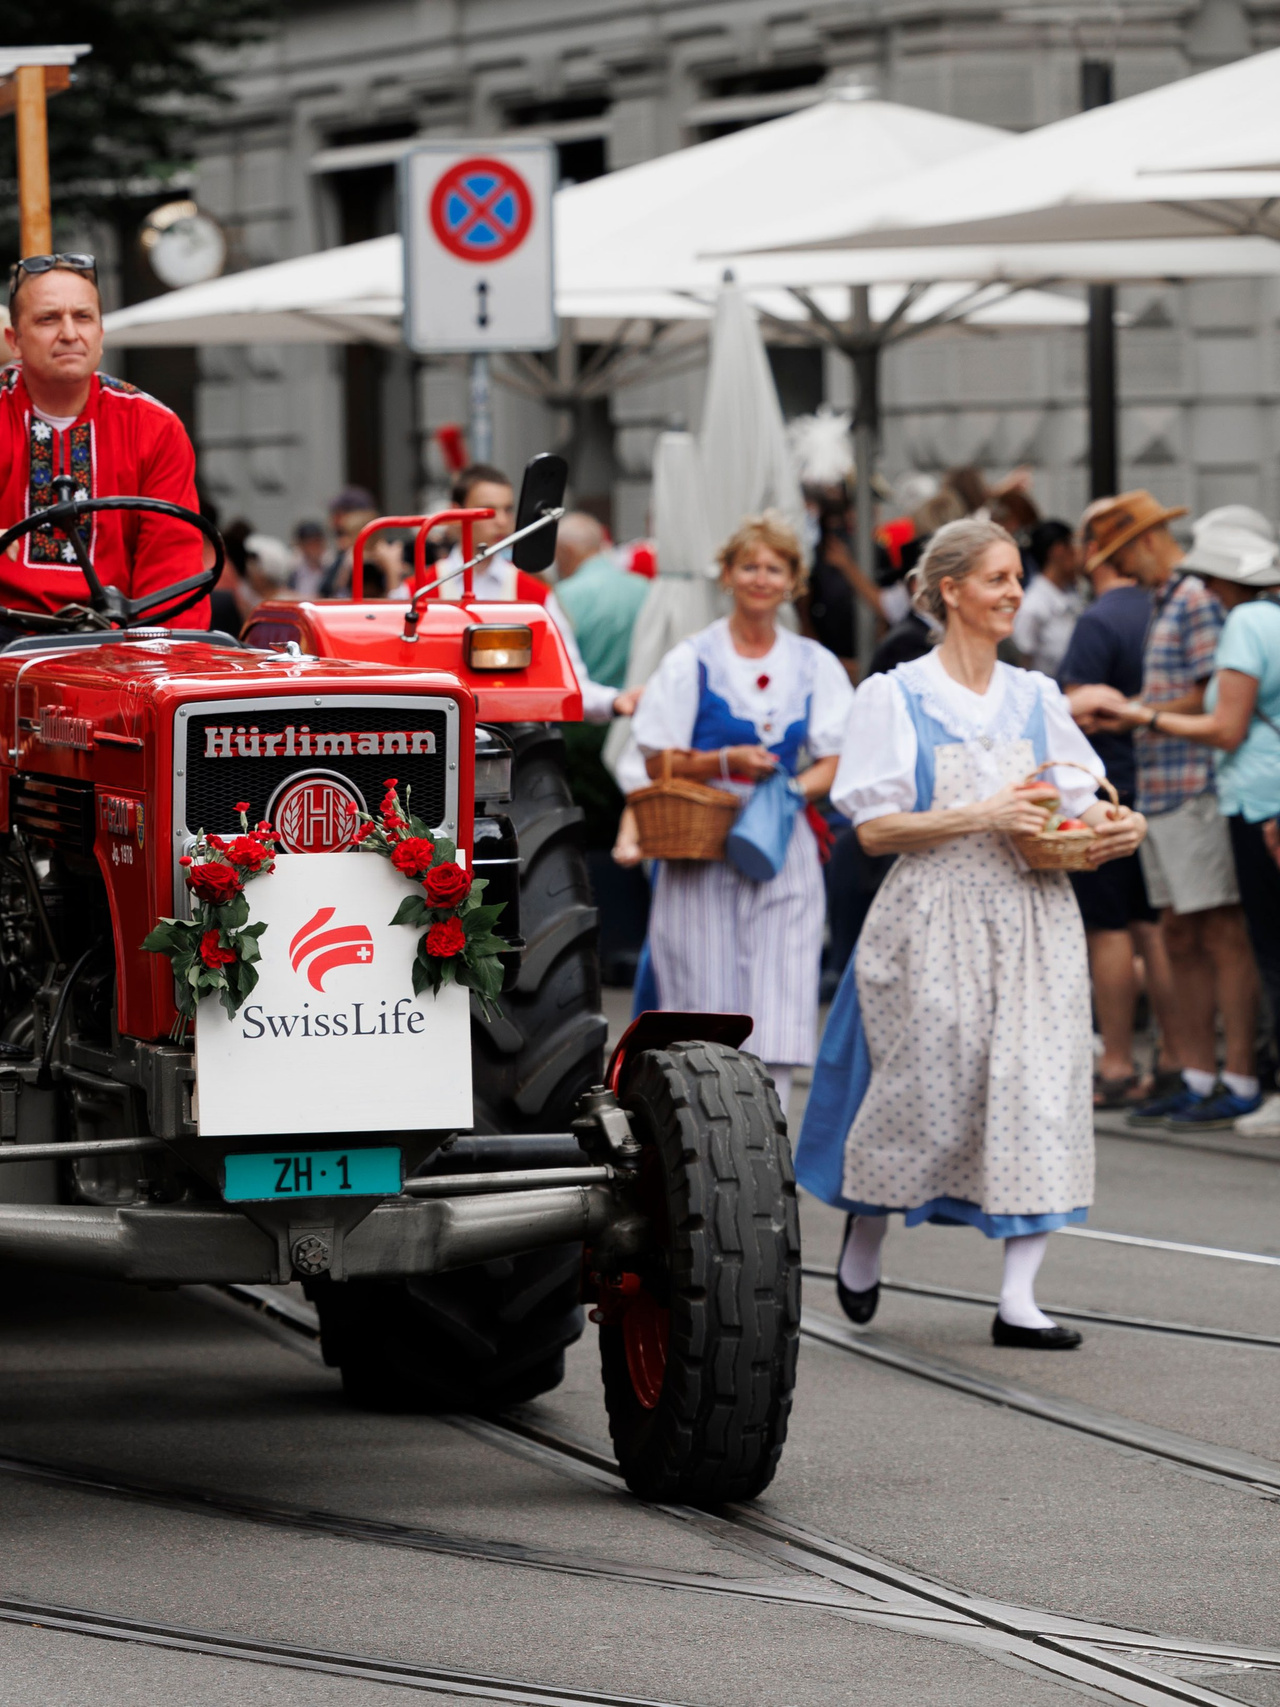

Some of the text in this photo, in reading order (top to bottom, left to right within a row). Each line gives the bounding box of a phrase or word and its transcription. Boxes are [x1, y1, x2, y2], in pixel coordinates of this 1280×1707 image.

[204, 725, 436, 758] Hürlimann
[303, 788, 334, 846] H
[242, 998, 425, 1039] SwissLife
